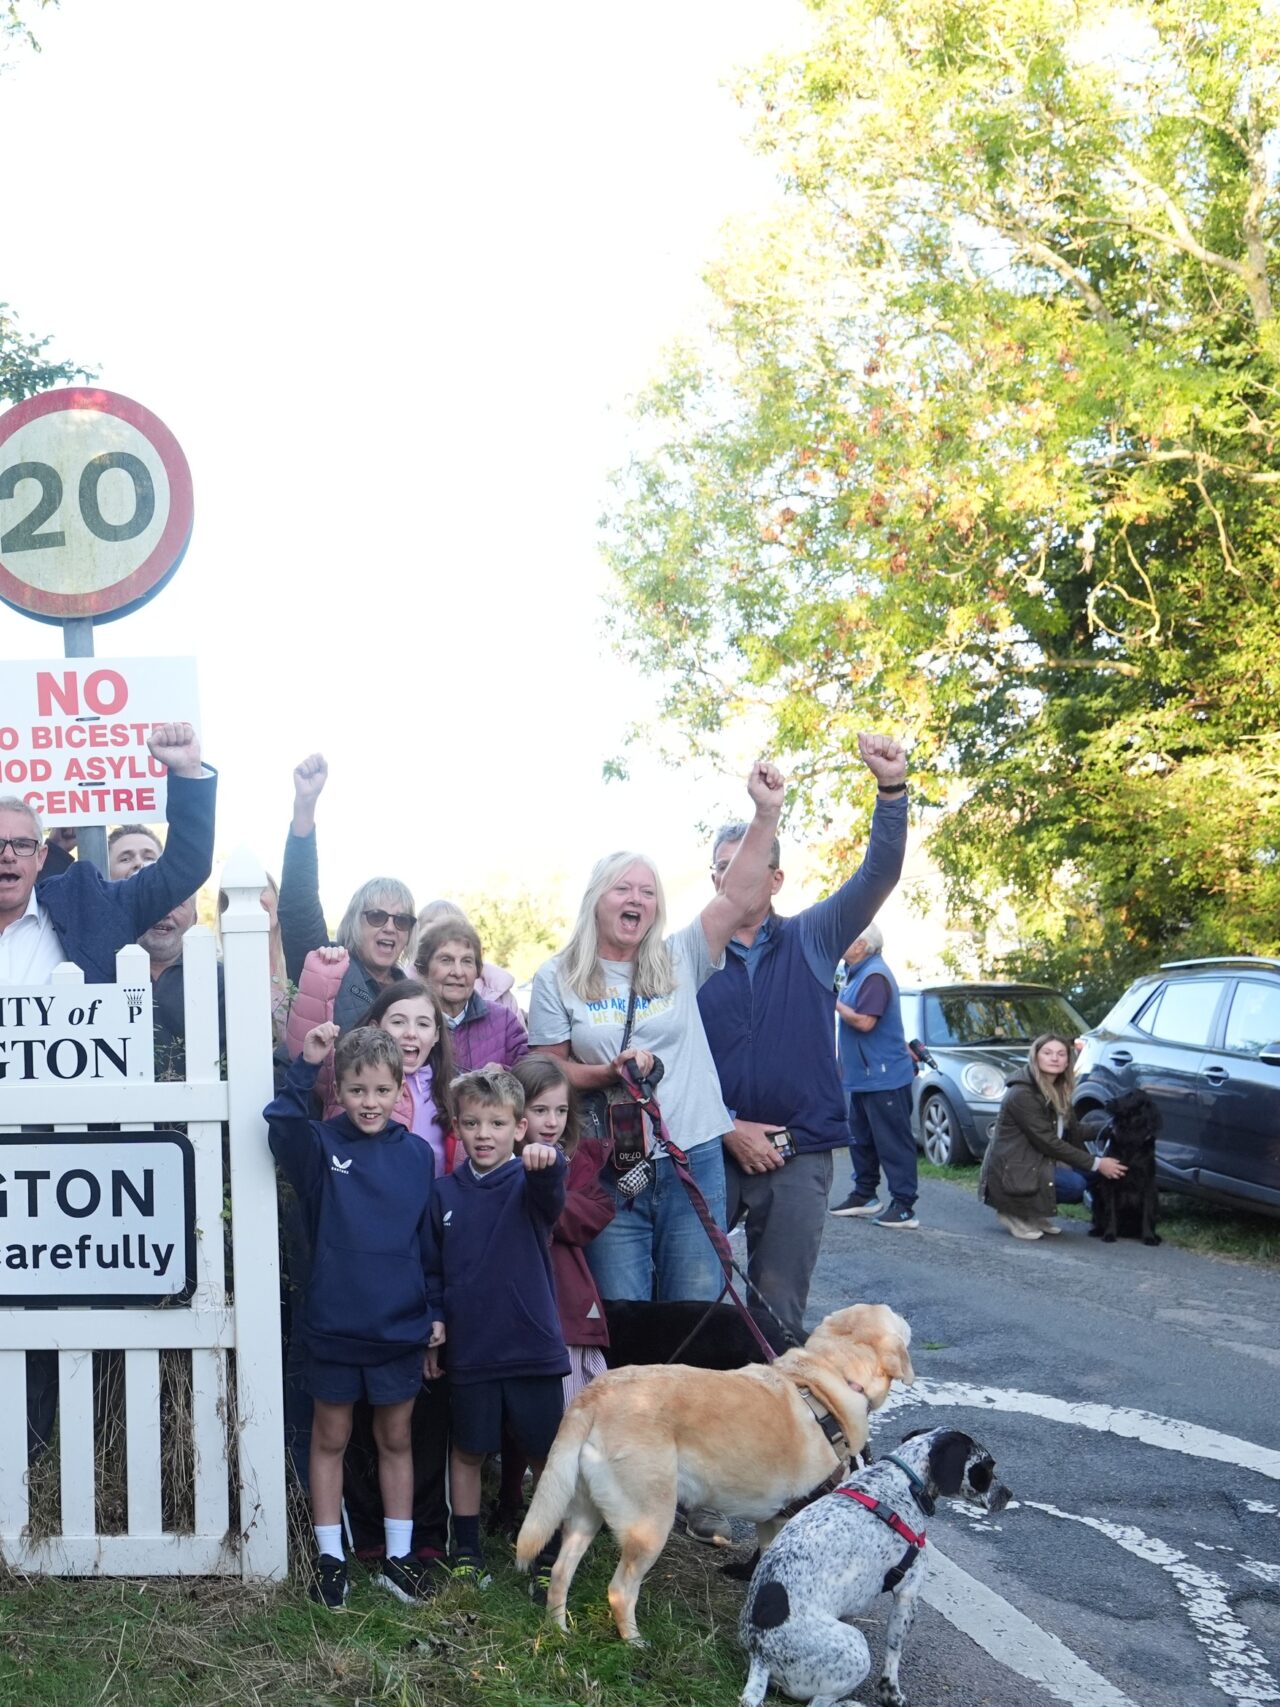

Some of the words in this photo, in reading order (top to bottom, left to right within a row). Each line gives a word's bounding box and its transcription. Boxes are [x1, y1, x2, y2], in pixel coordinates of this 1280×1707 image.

[36, 669, 129, 717] NO
[31, 722, 192, 750] BICEST
[64, 755, 168, 781] ASYLU
[68, 999, 103, 1026] of
